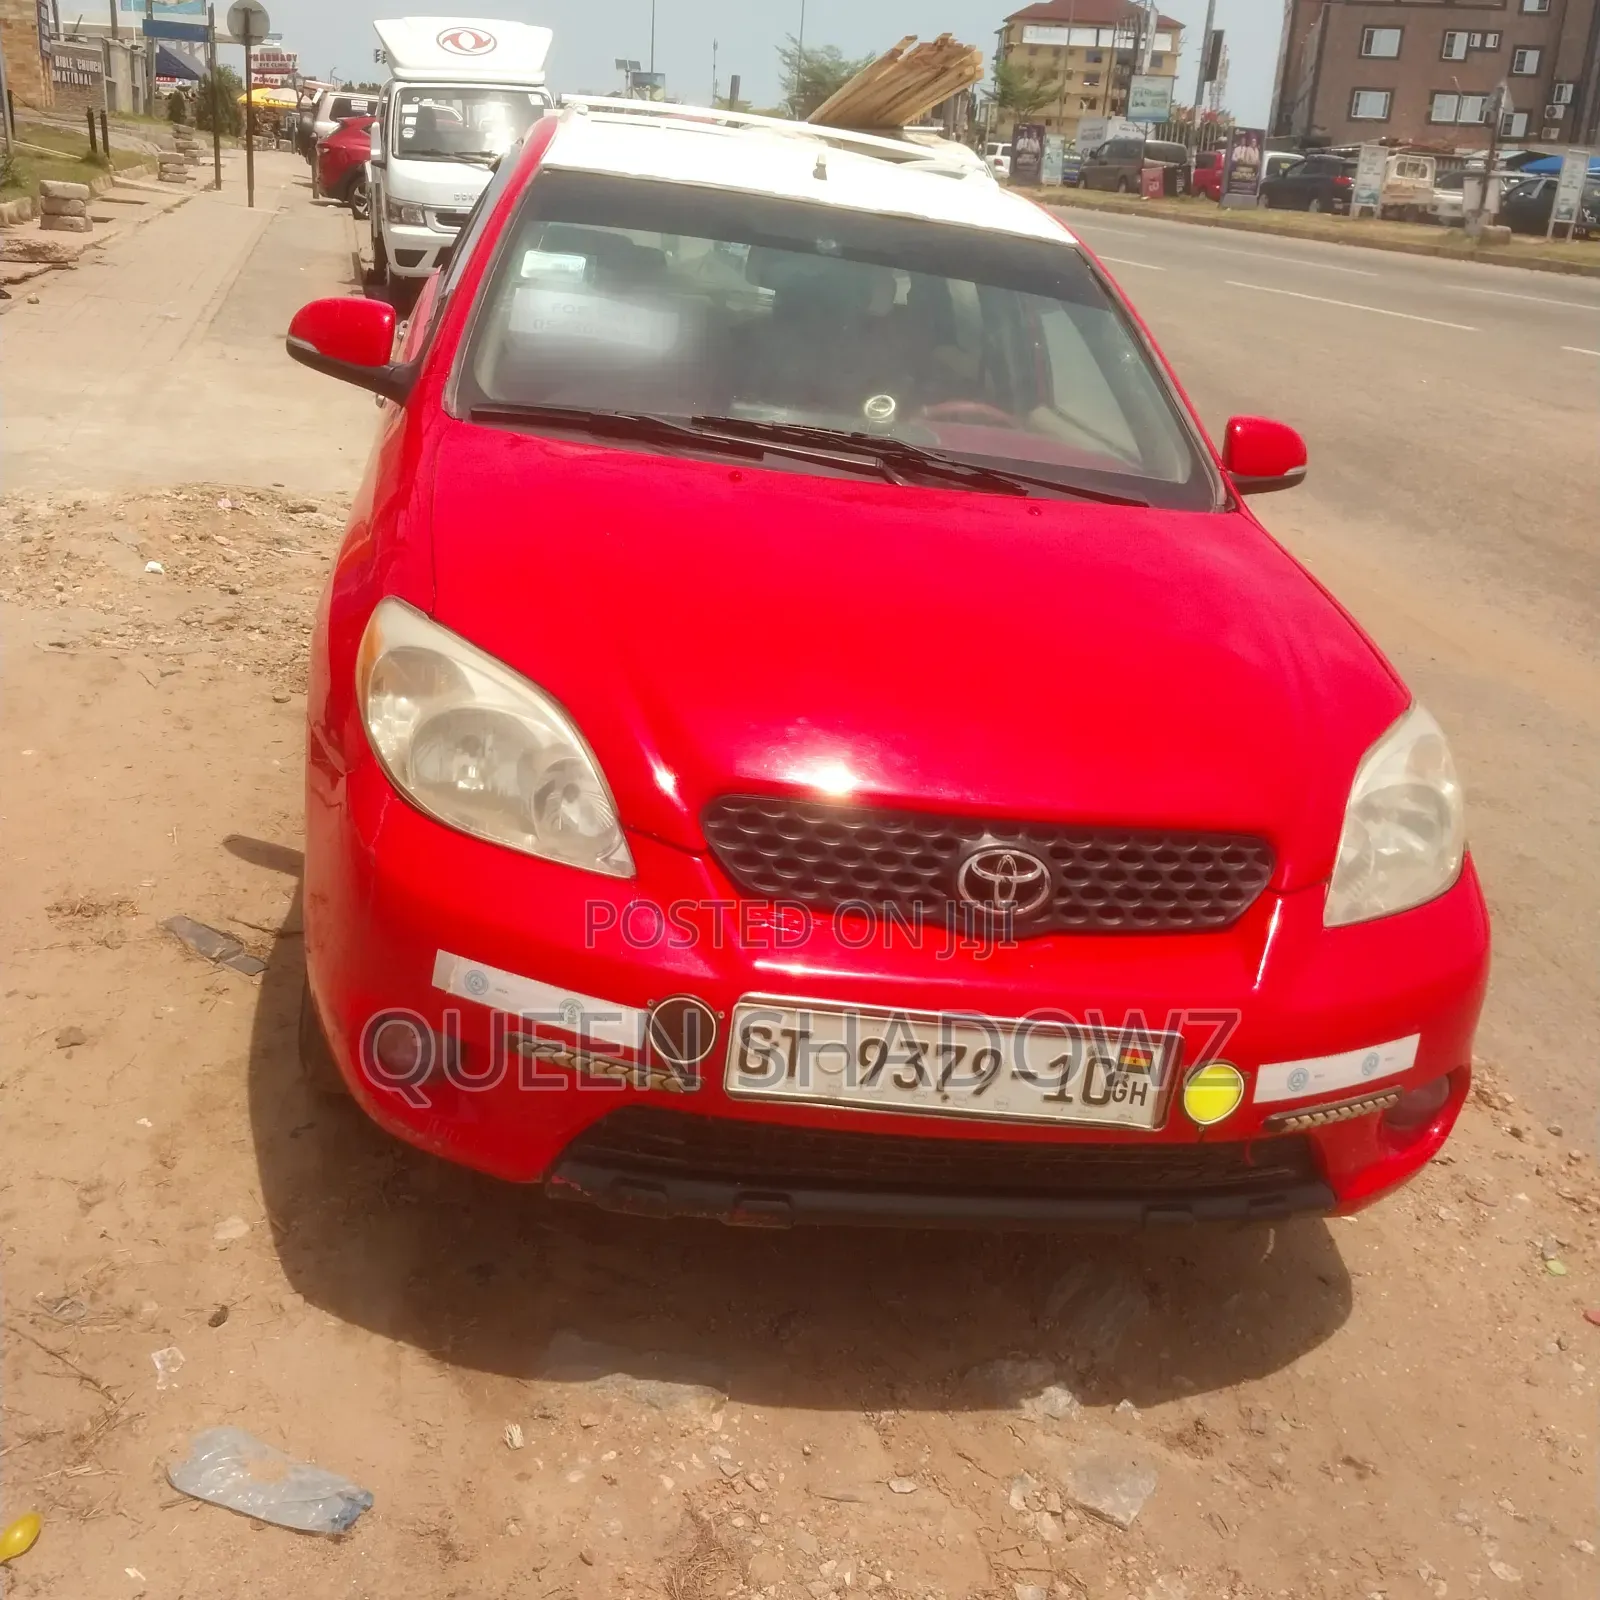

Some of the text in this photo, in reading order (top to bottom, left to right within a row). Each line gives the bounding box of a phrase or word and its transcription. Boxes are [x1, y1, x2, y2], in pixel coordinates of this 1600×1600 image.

[55, 55, 102, 72] BIBLE CHURCH
[738, 1025, 812, 1078] GT
[1111, 1078, 1148, 1106] GH
